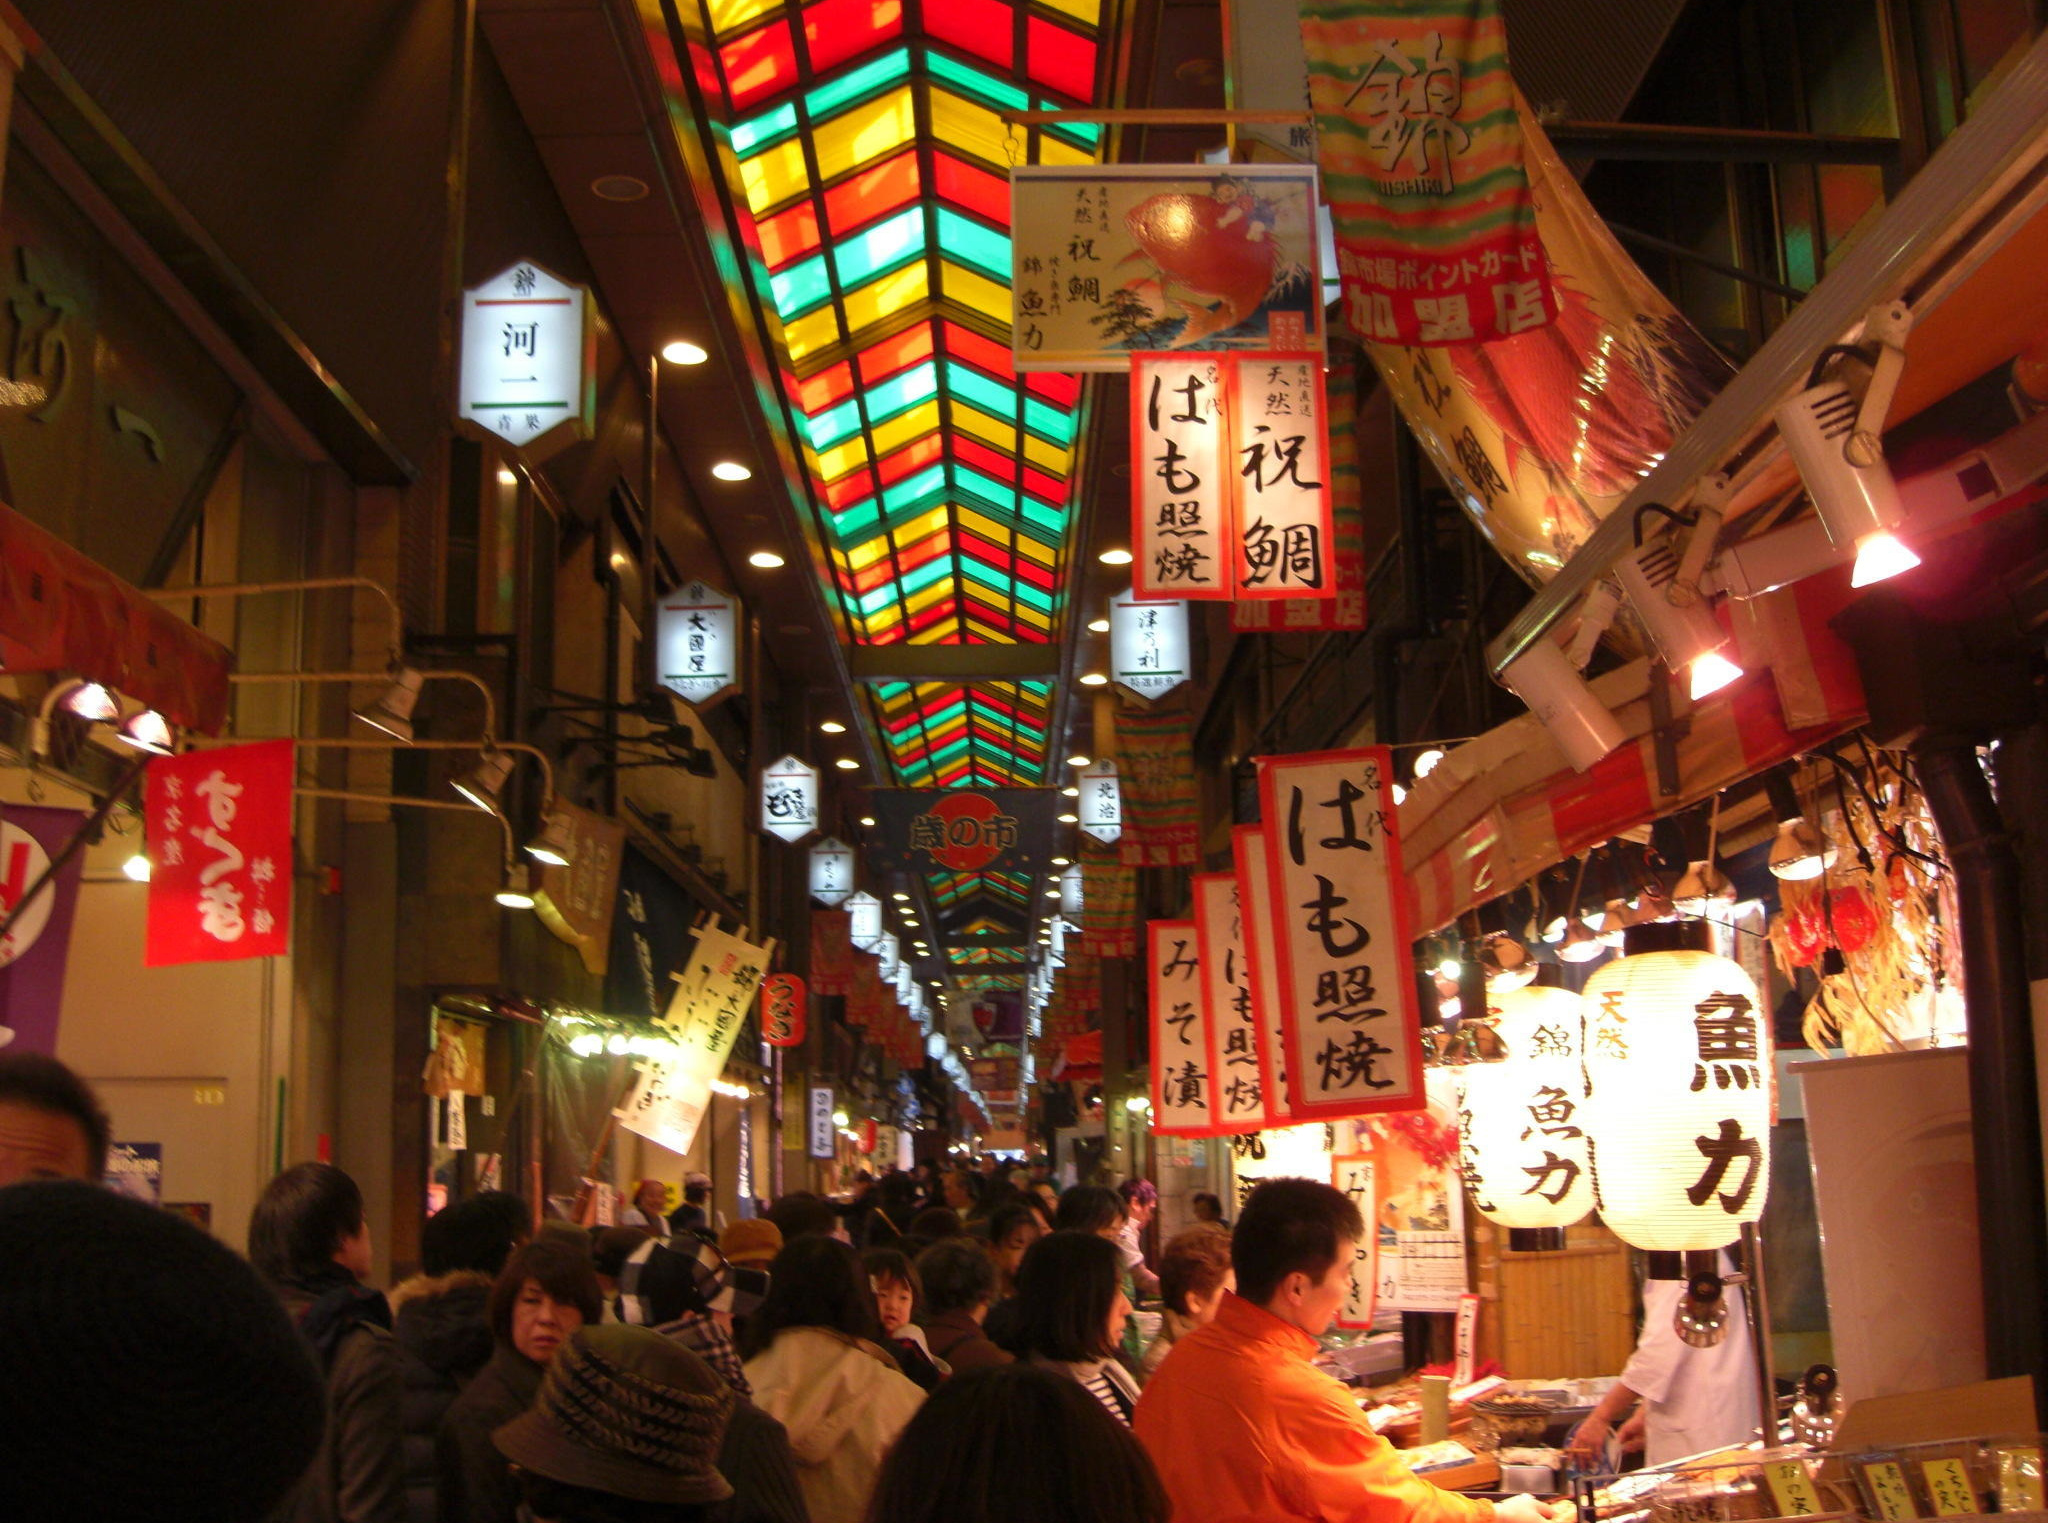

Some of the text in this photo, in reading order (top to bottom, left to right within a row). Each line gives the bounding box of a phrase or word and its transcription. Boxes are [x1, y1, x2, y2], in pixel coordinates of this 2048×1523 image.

[1066, 234, 1101, 305] 祝鯛
[1019, 288, 1048, 351] 魚力
[1347, 278, 1547, 342] 加盟店
[502, 321, 540, 384] 河一
[1264, 364, 1292, 417] 天然
[1147, 373, 1211, 585] はも照焼
[1240, 424, 1324, 589] 祝鯛
[1362, 764, 1393, 838] 名代
[1286, 777, 1394, 1091] はも照焼
[1163, 939, 1208, 1109] みそ漬
[1595, 990, 1630, 1060] 天然
[1520, 1023, 1586, 1204] 錦 魚力
[1684, 990, 1763, 1215] 魚力
